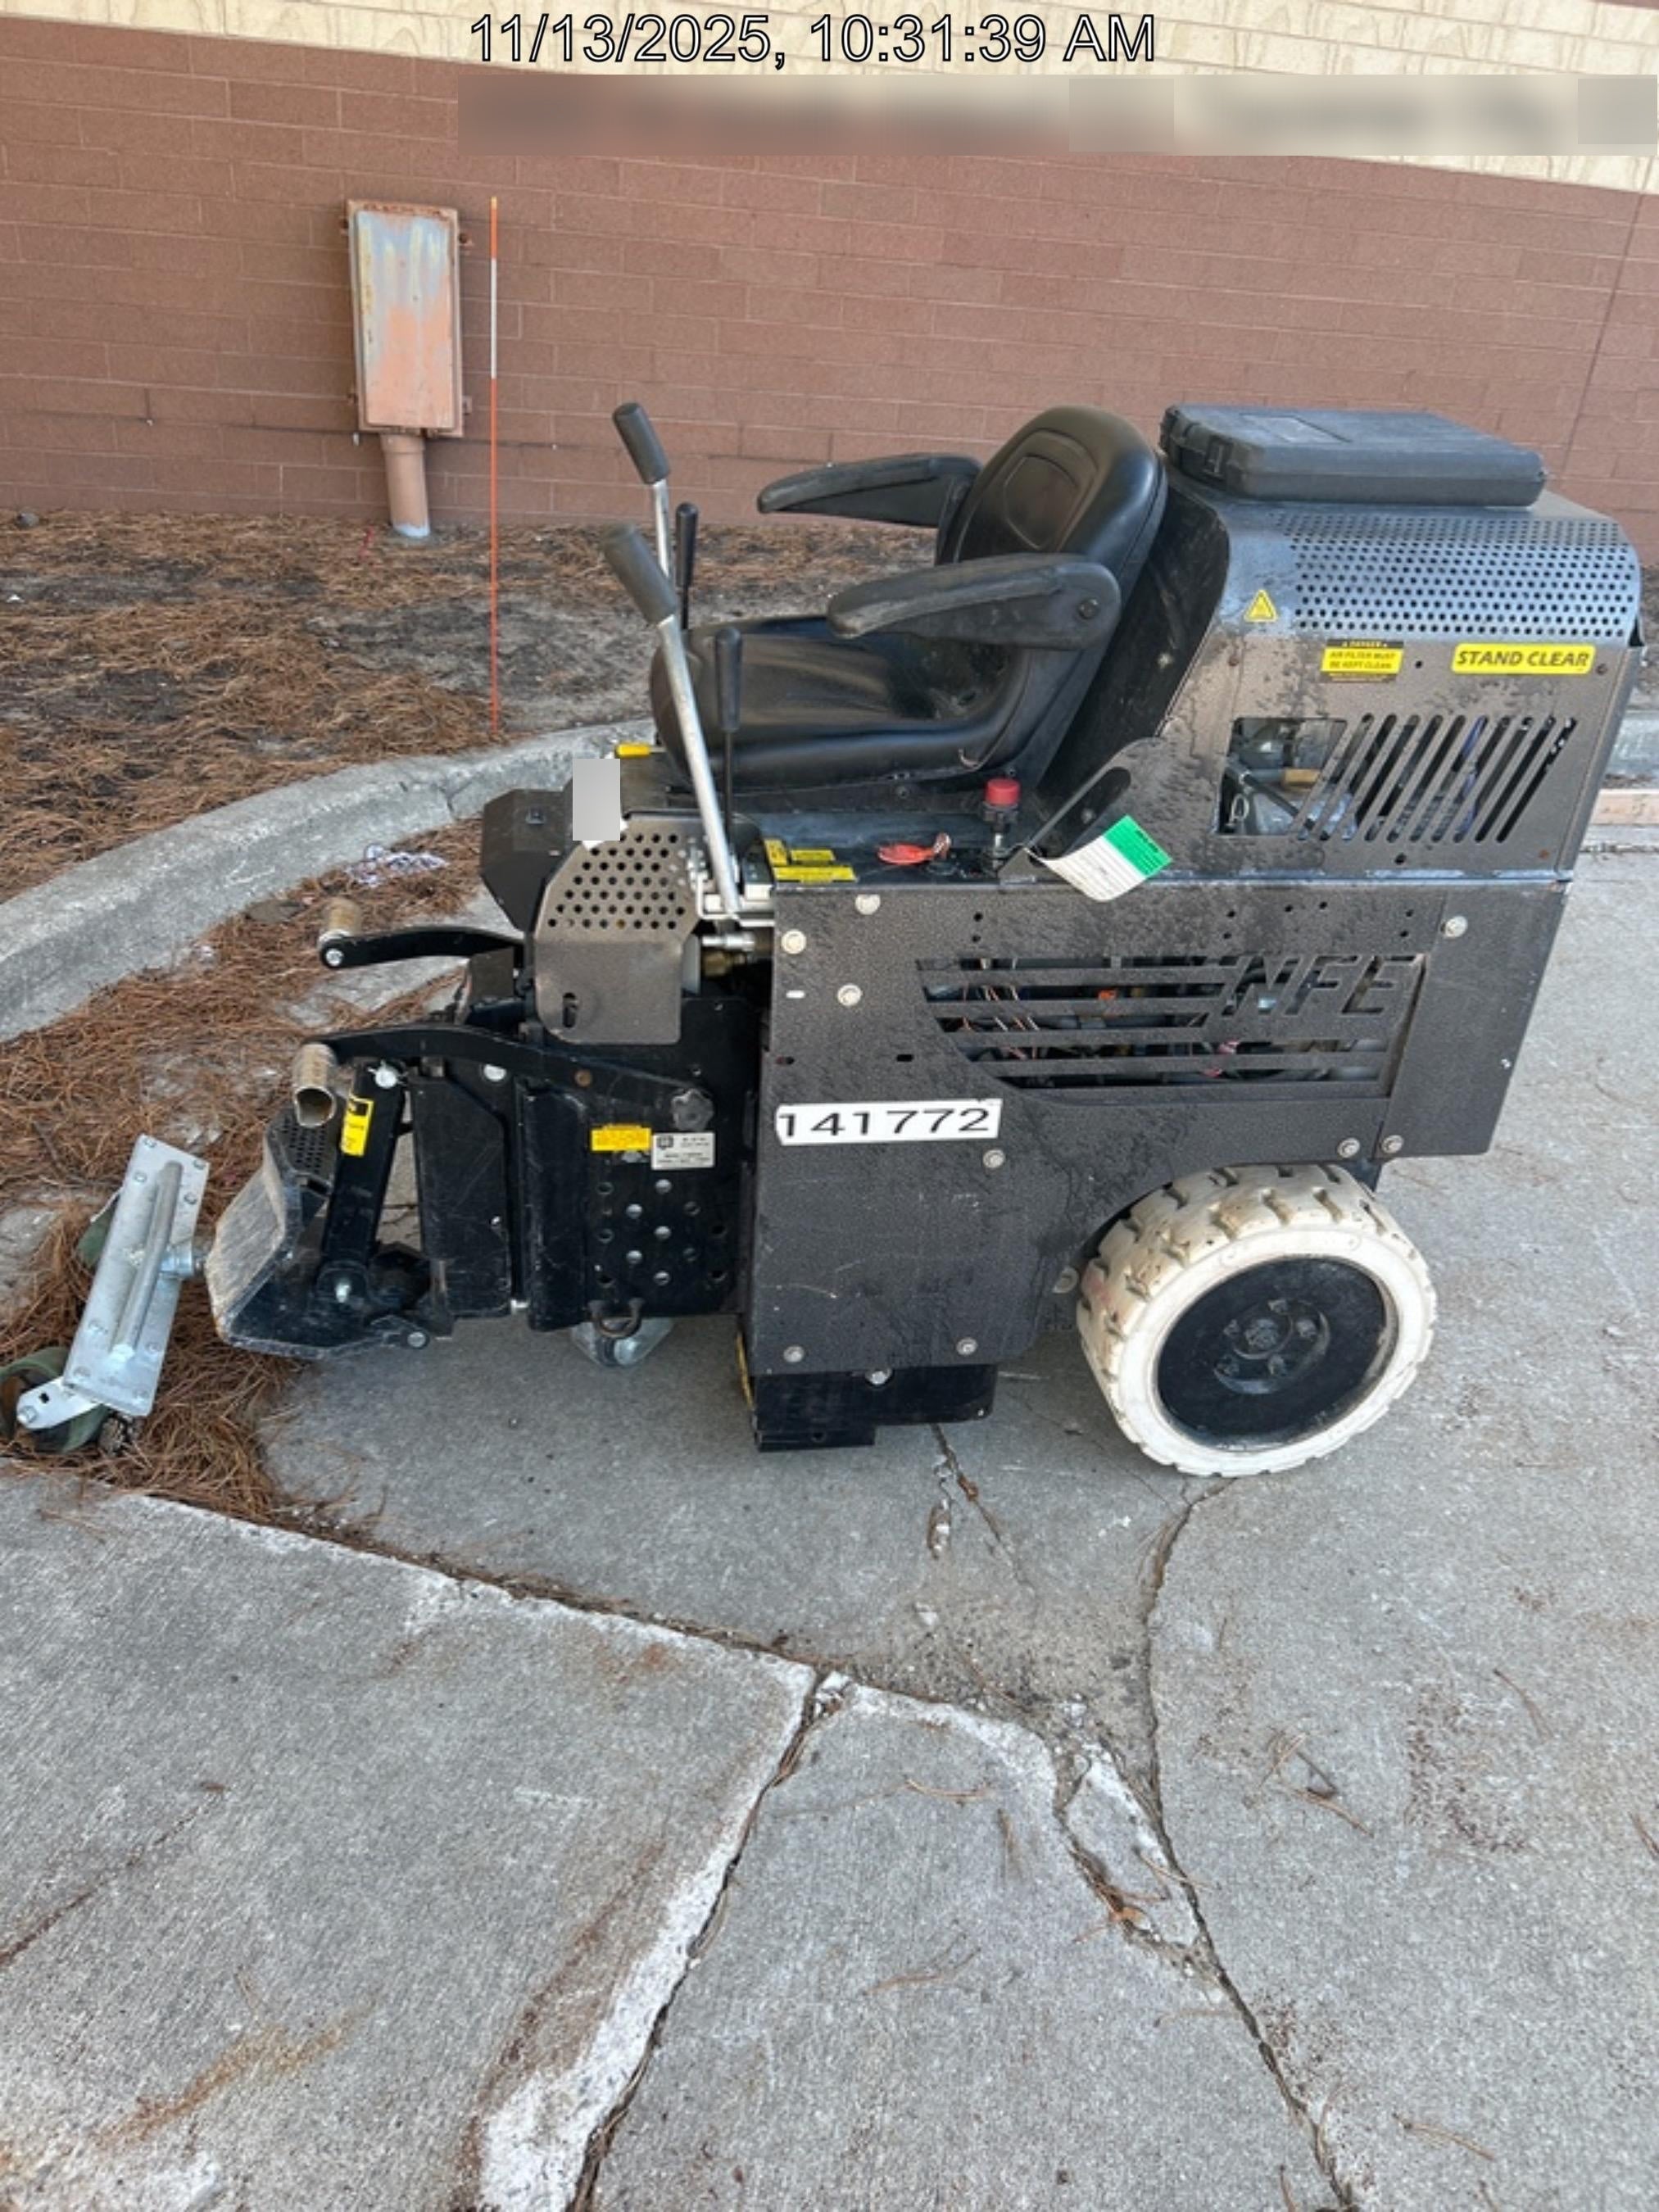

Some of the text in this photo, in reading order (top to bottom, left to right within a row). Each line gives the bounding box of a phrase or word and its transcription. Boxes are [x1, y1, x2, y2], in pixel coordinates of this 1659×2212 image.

[1457, 650, 1590, 667] STAND CLEAR
[1222, 954, 1416, 1015] NFE
[778, 1107, 990, 1137] 141772
